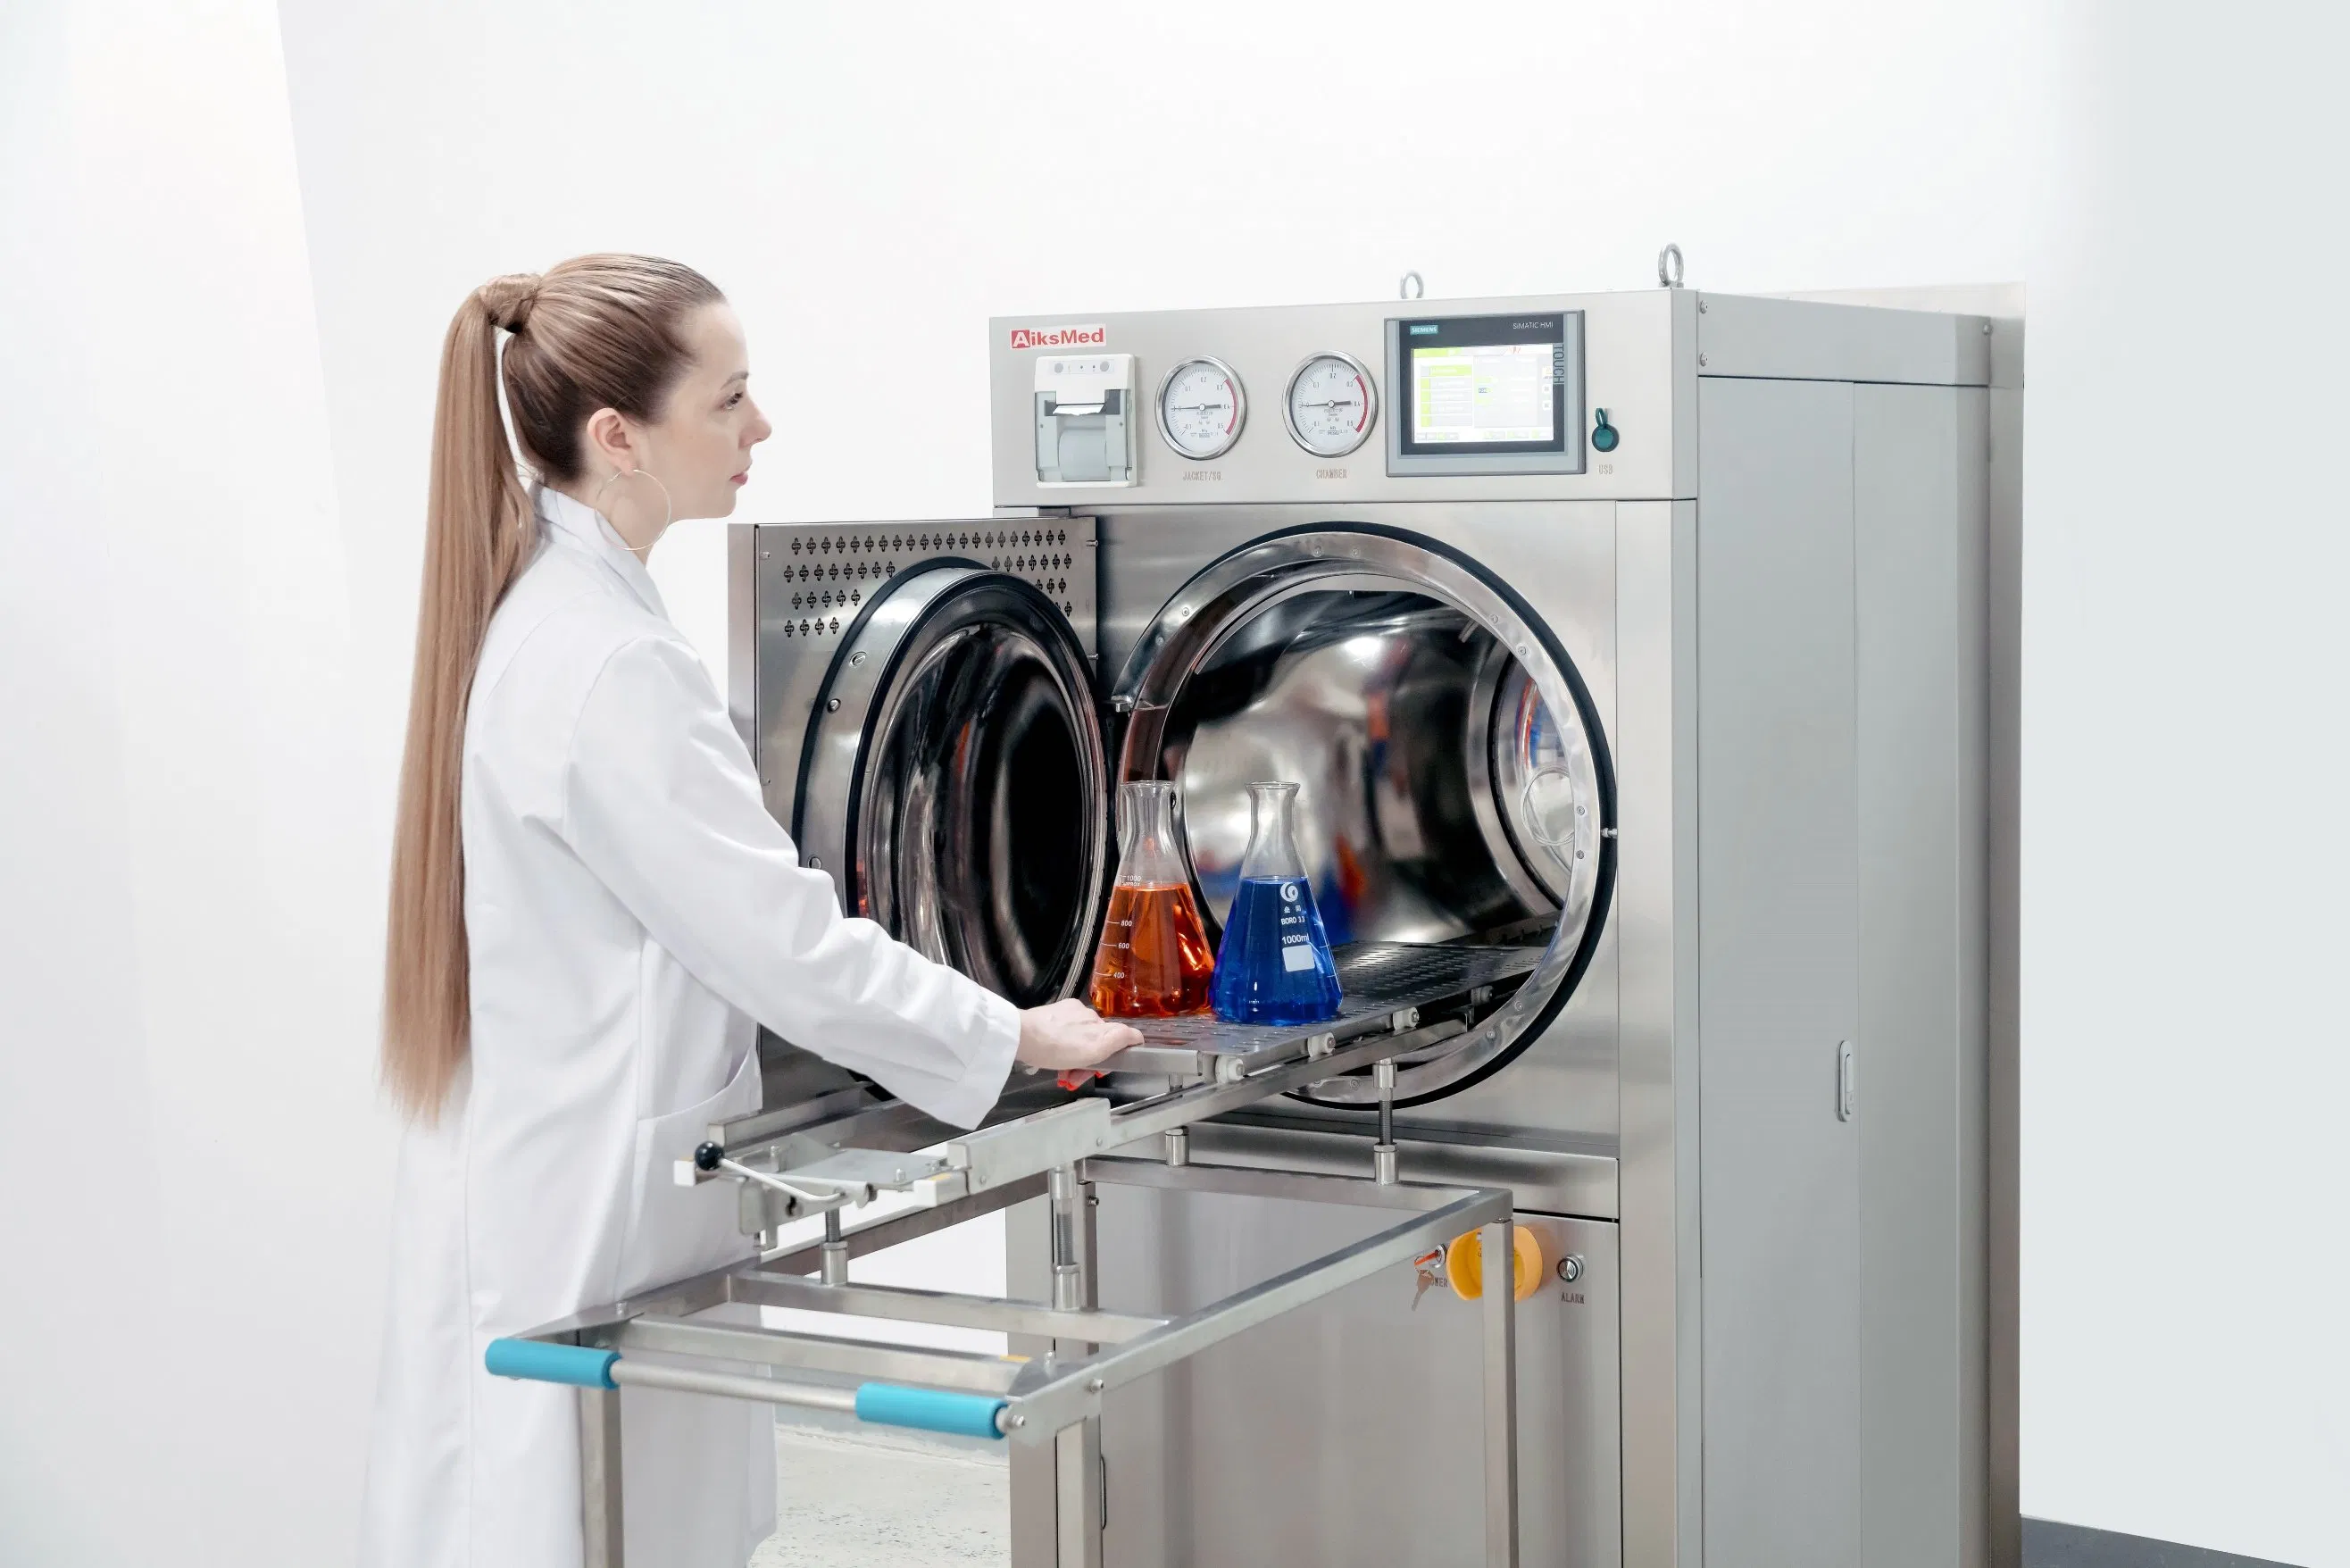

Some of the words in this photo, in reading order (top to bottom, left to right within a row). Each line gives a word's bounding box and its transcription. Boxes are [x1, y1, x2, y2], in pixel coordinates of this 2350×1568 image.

[1512, 321, 1538, 329] SIMATIC
[1540, 321, 1554, 329] HMI
[1011, 327, 1104, 349] AiksMed
[1554, 344, 1564, 384] TOUCH
[1280, 916, 1297, 926] BORO
[1281, 932, 1310, 944] 1000ml
[1561, 1292, 1585, 1305] ALARM
